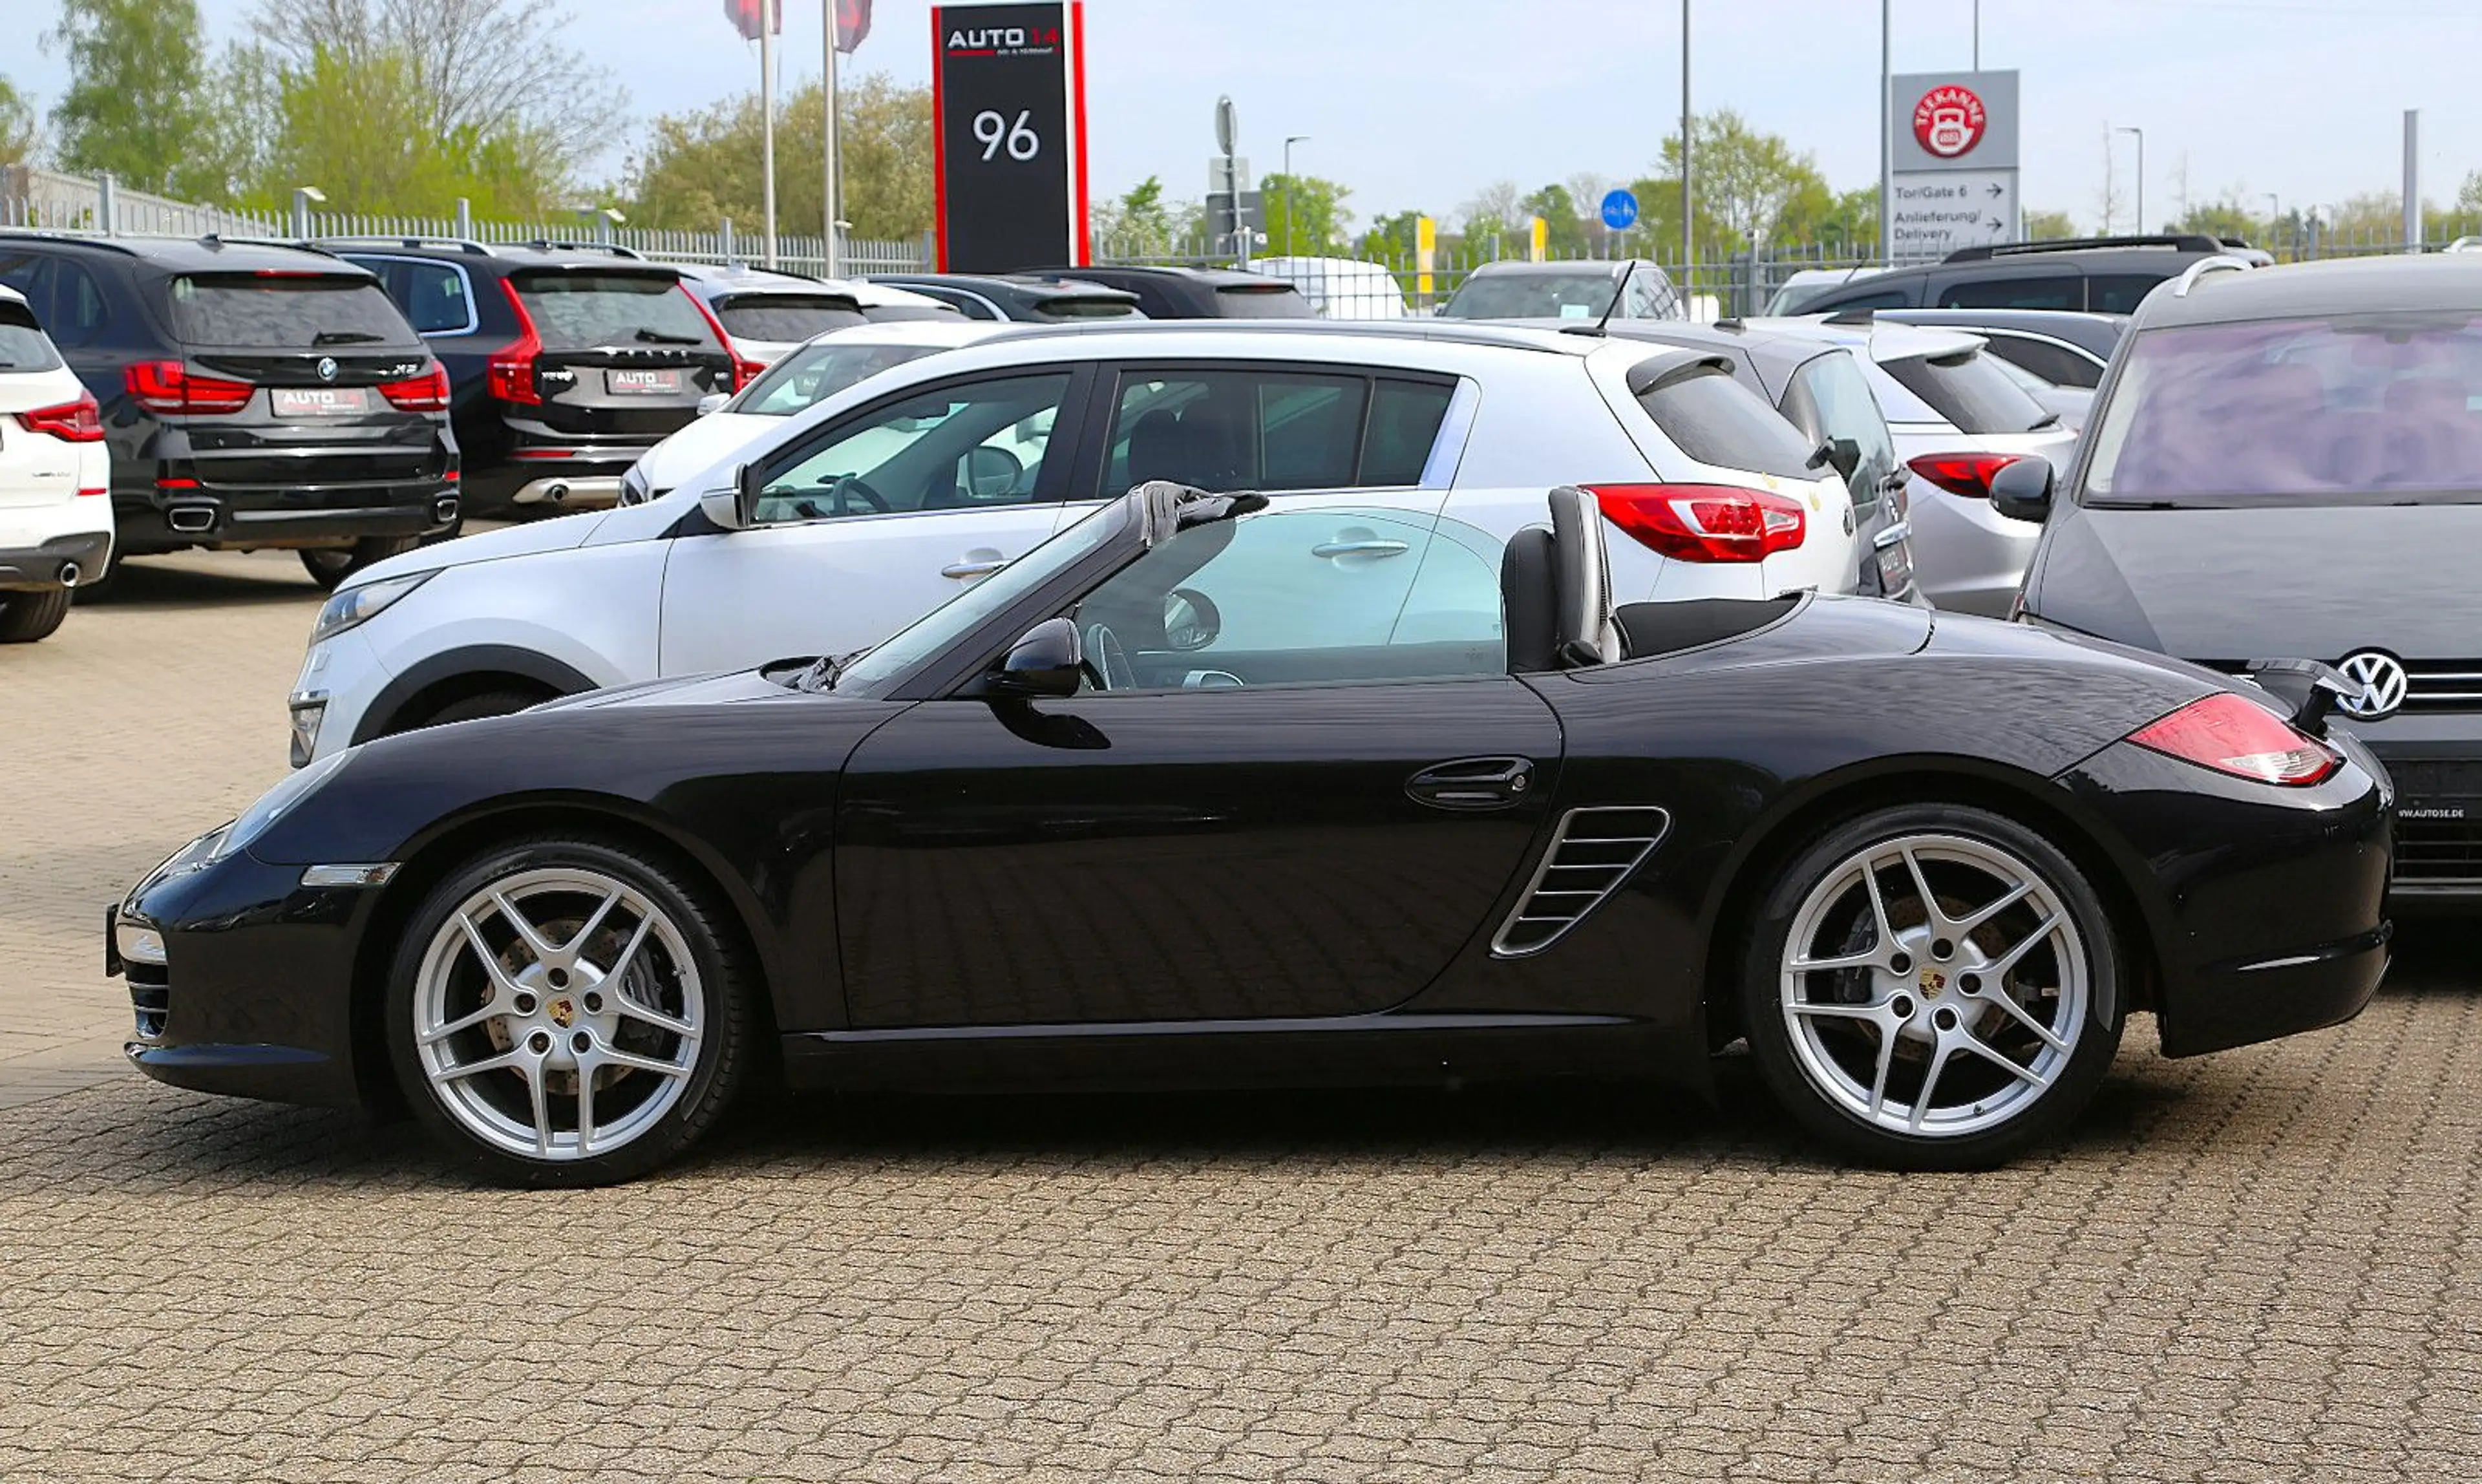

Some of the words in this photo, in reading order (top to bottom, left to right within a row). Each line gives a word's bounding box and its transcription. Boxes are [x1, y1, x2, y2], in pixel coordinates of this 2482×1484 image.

[948, 28, 1024, 48] AUTO
[1032, 27, 1059, 45] 14
[1915, 89, 1984, 127] TEEKANNE
[973, 109, 1039, 160] 96
[1959, 184, 1967, 198] 6
[1895, 228, 1951, 241] Delivery
[615, 372, 657, 384] AUTO
[284, 390, 335, 405] AUTO
